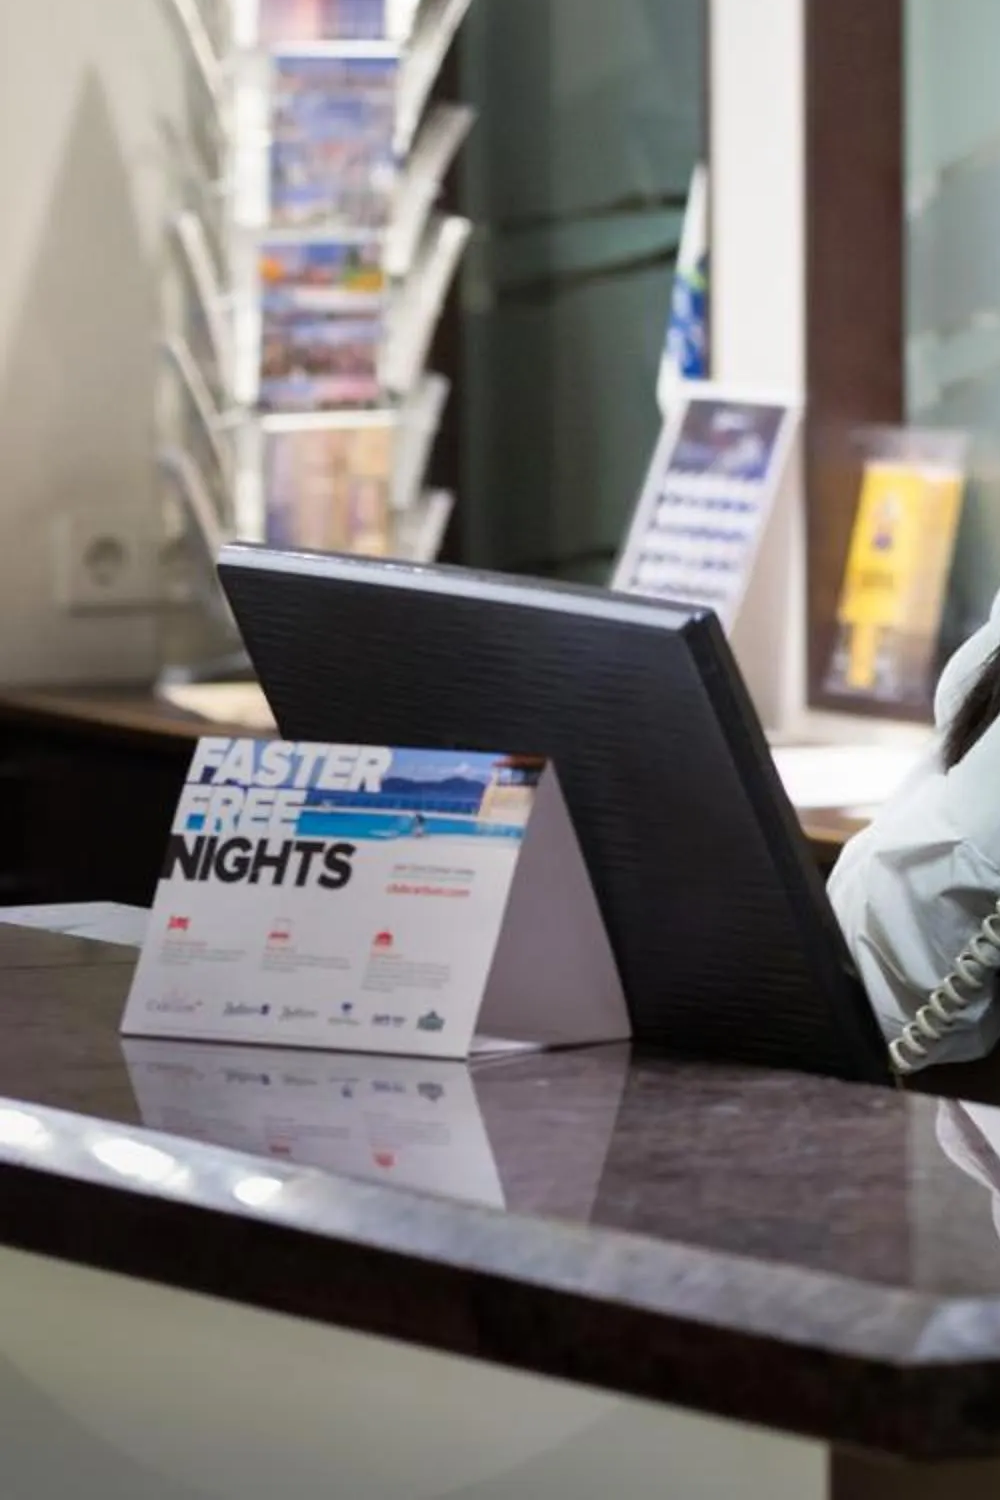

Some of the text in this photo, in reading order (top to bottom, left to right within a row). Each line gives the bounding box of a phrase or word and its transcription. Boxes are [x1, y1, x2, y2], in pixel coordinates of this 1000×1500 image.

[186, 737, 393, 793] FASTER
[171, 783, 308, 837] FREE
[158, 833, 357, 890] NIGHTS
